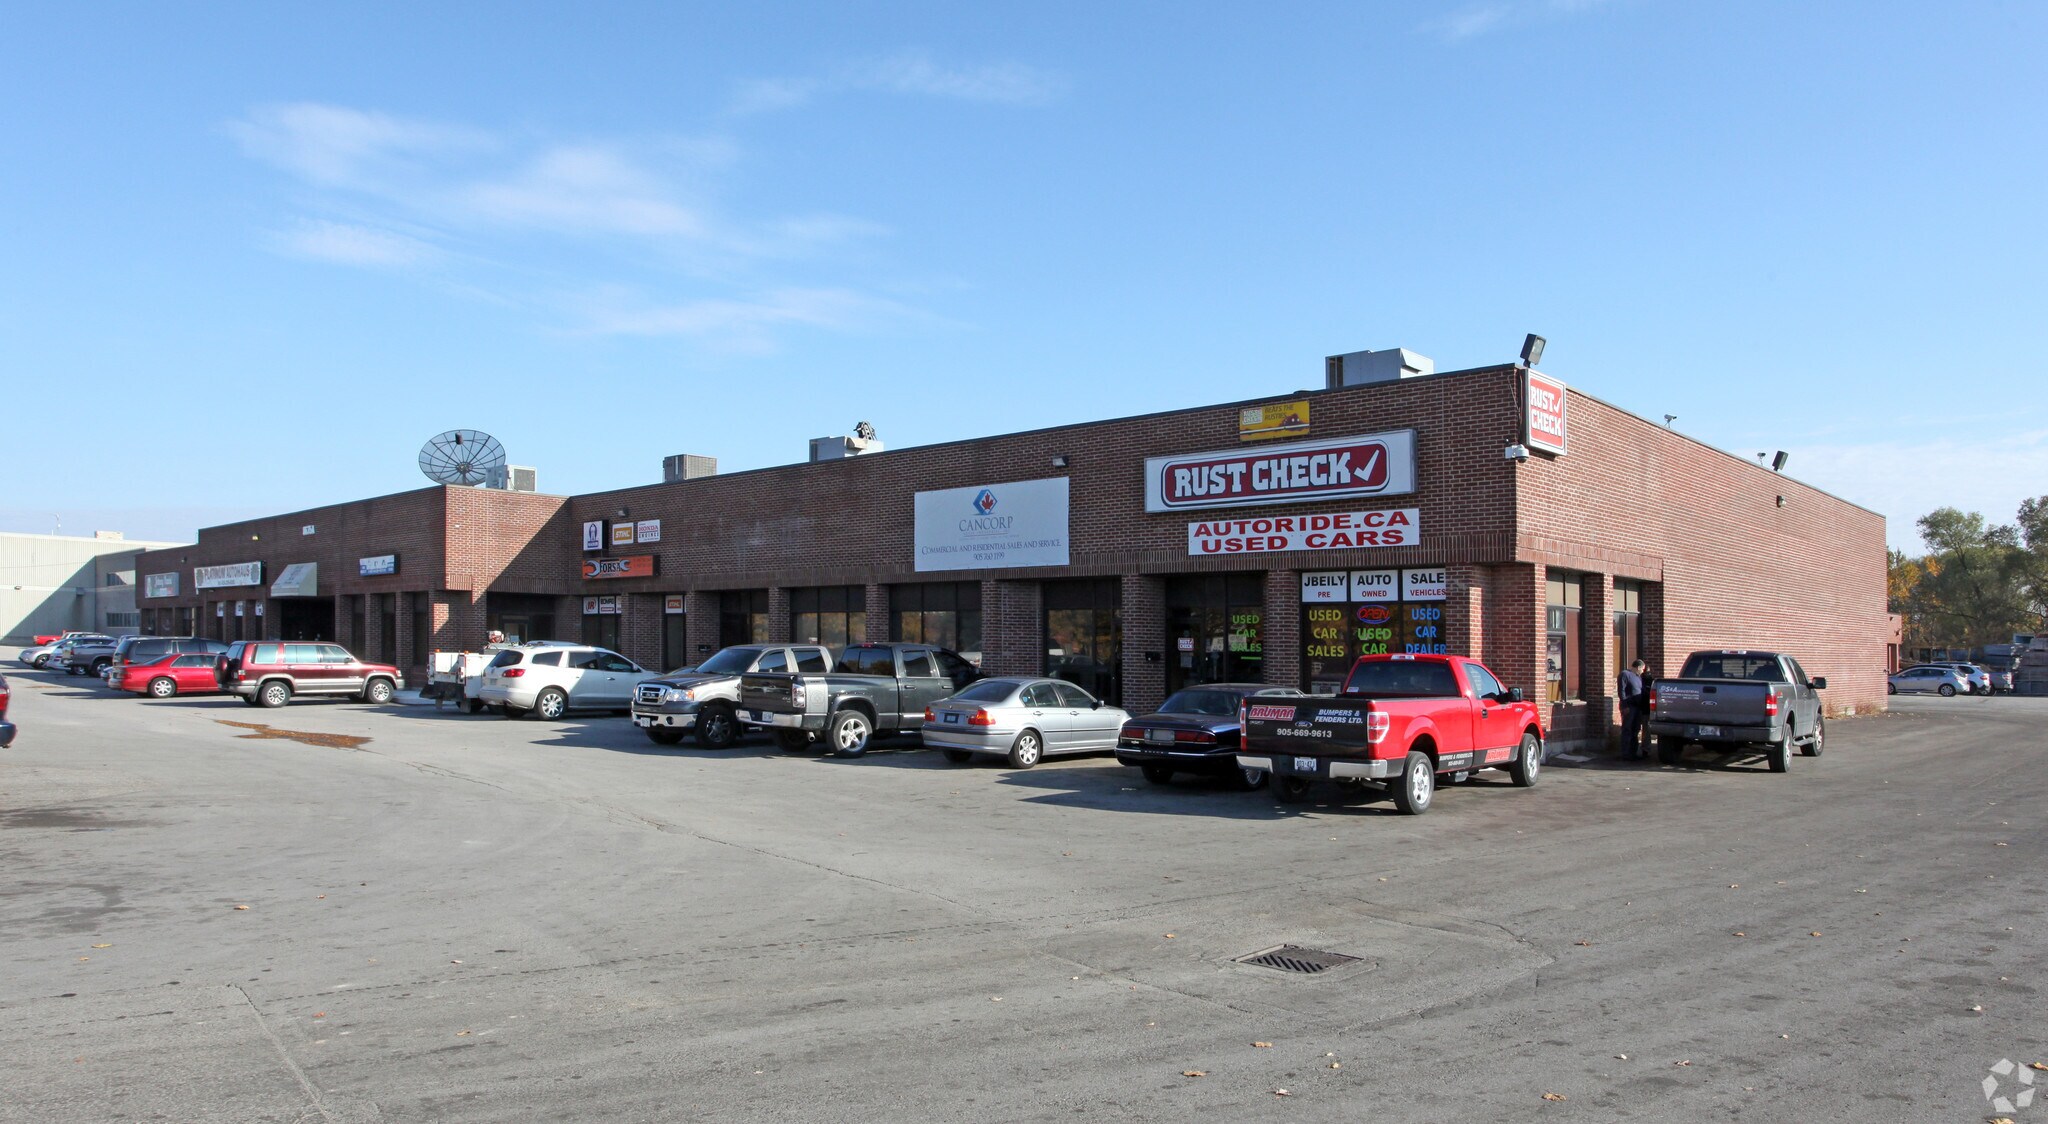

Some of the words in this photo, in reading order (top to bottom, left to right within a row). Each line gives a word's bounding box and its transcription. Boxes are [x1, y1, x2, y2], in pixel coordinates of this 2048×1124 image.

[1530, 386, 1555, 413] RUST
[1531, 408, 1562, 437] CHECK
[1174, 462, 1247, 498] RUST
[1252, 451, 1351, 491] CHECK
[959, 516, 1013, 531] CANCORP
[1194, 510, 1410, 538] AUTORIDE.CA
[972, 543, 1006, 552] RESIDENTIAL
[1007, 541, 1022, 550] SALES
[1023, 540, 1037, 549] AND
[1038, 539, 1061, 548] SERVICE
[1201, 535, 1288, 553] USED
[1305, 529, 1404, 548] CARS
[1304, 576, 1346, 587] JBEILY
[1357, 574, 1392, 586] AUTO
[1362, 590, 1387, 598] OWNED
[1410, 588, 1446, 597] VEHICLES
[1232, 614, 1260, 624] USED
[1309, 609, 1342, 621] USED
[1358, 608, 1391, 619] OPEN
[1411, 608, 1441, 620] USED
[1236, 628, 1257, 638] CAR
[1313, 627, 1338, 639] CAR
[1357, 628, 1392, 640] USED
[1415, 626, 1437, 638] CAR
[1231, 642, 1262, 652] SALES
[1307, 645, 1345, 657] SALES
[1361, 643, 1387, 654] CAR
[1405, 643, 1446, 654] DEALER
[1277, 728, 1332, 738] 905-669-9613
